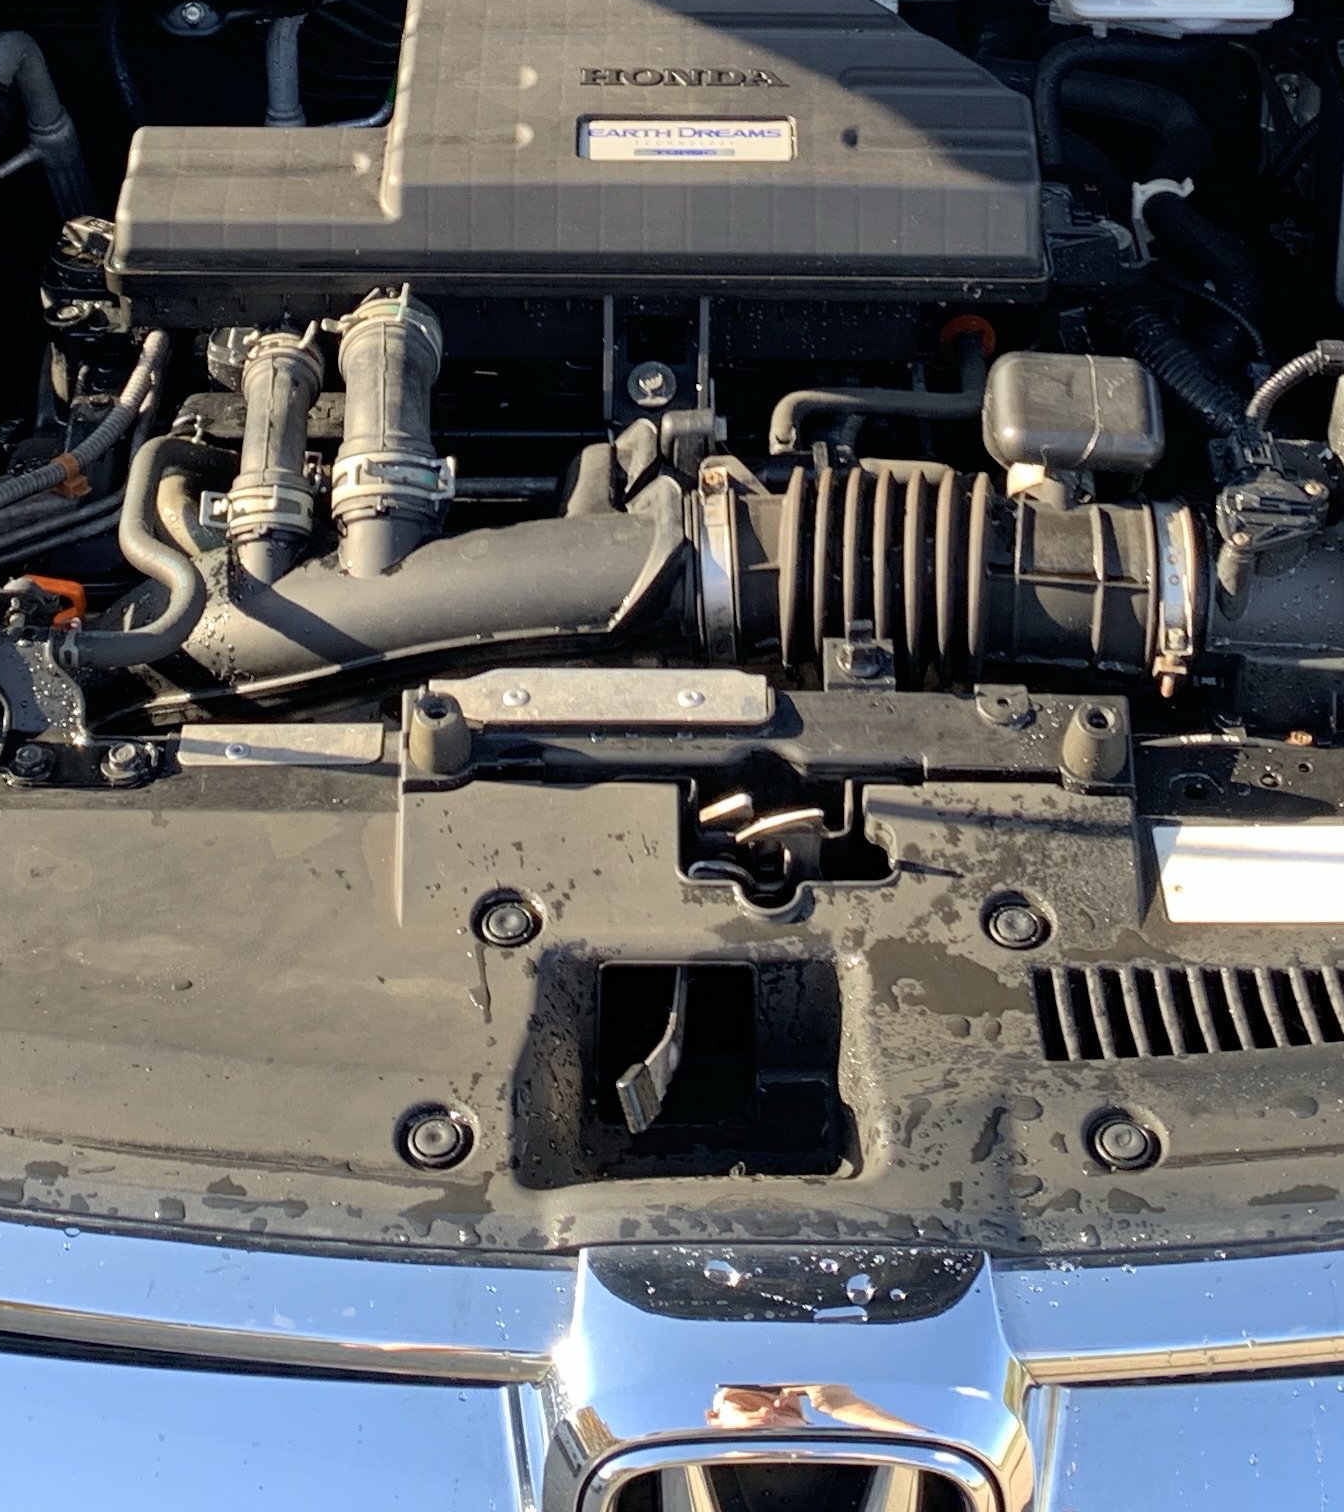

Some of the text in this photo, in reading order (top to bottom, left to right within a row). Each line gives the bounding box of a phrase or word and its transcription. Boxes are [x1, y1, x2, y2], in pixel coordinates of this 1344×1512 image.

[580, 68, 790, 86] HONDA
[588, 126, 782, 138] EARTH DREAMS
